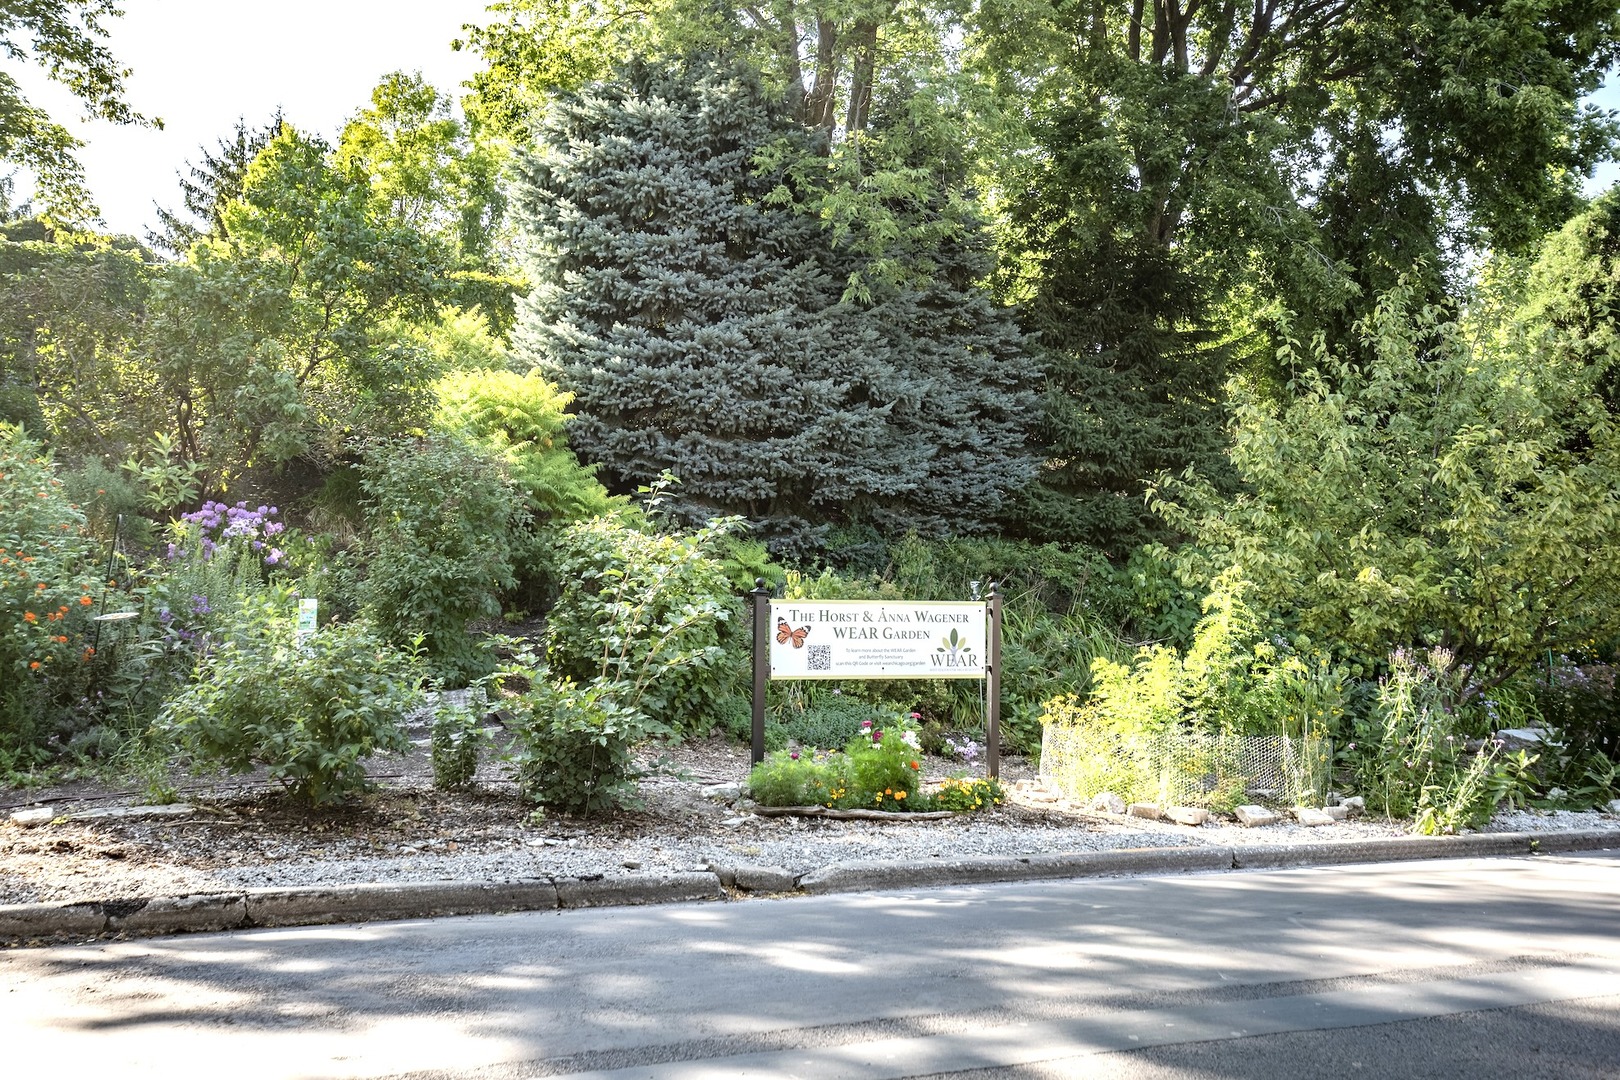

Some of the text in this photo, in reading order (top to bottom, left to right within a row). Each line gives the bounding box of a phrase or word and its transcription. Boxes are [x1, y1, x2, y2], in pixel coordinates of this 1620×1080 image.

[789, 609, 969, 623] THE HORST & ANNA WAGENER
[833, 626, 930, 640] WEAR GARDEN
[930, 654, 978, 667] WEAR
